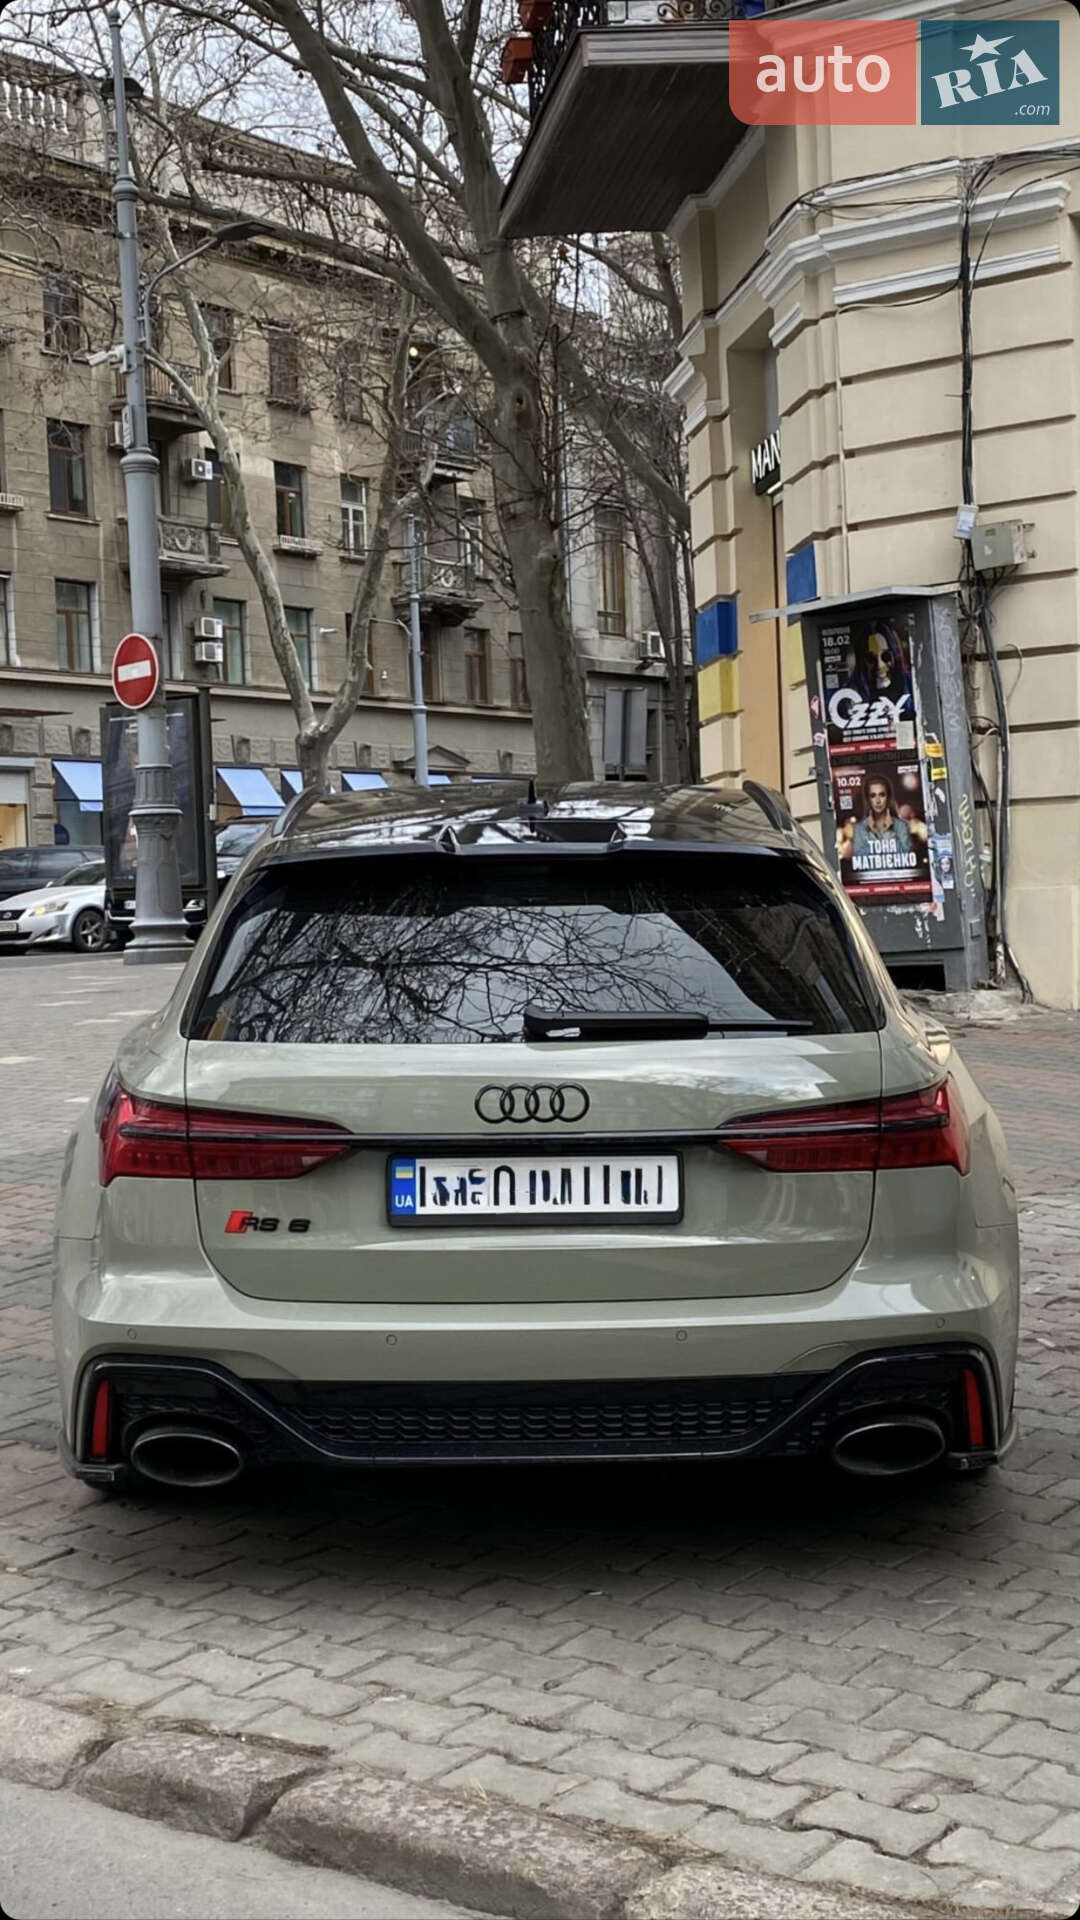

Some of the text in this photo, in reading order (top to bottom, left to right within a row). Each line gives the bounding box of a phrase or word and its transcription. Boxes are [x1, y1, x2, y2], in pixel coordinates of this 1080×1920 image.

[821, 634, 851, 648] 18.02
[836, 776, 862, 788] 10.02
[394, 1194, 414, 1208] UA
